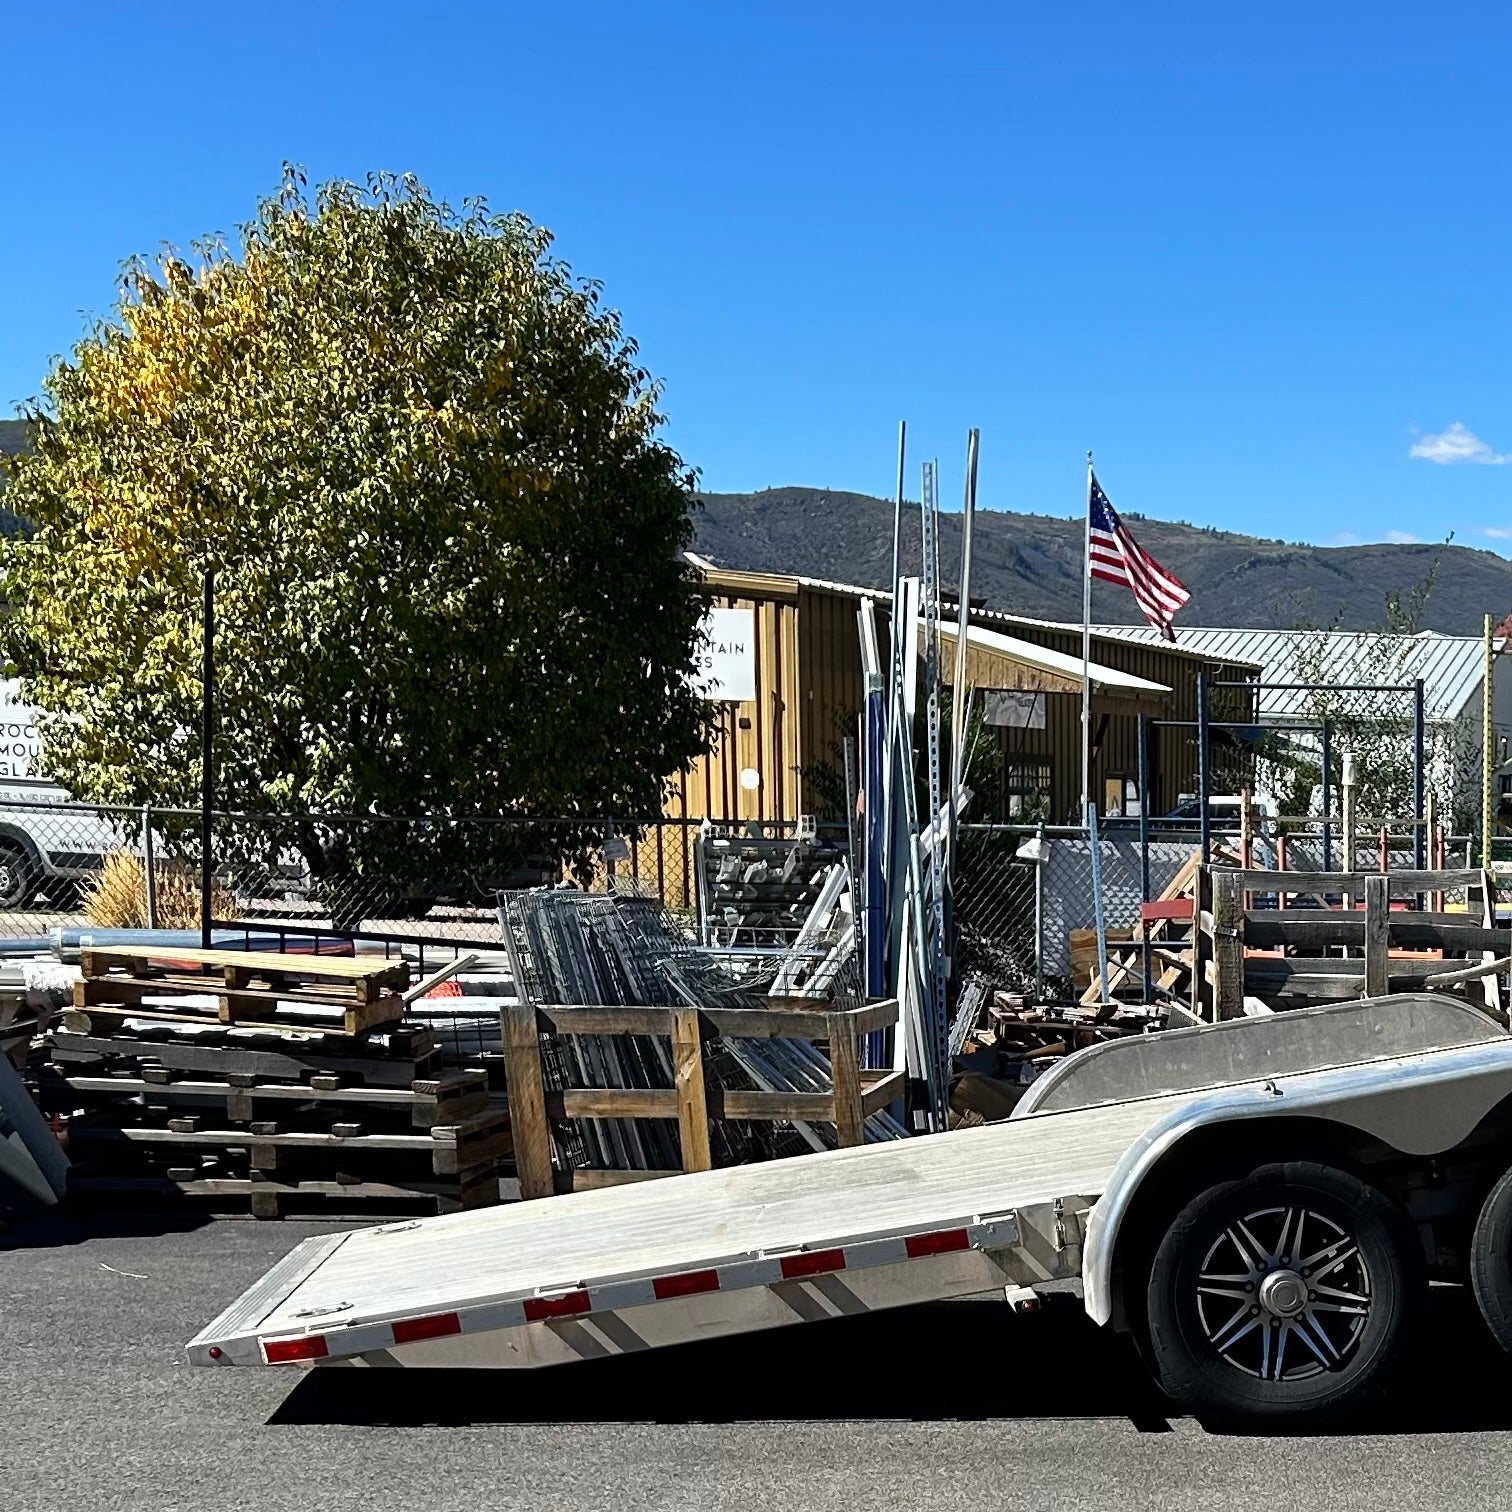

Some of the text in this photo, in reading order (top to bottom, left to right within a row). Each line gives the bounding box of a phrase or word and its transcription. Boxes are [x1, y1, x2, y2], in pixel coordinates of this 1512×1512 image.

[697, 642, 744, 655] NTAIN
[0, 724, 35, 739] ROC
[0, 743, 40, 757] MOU
